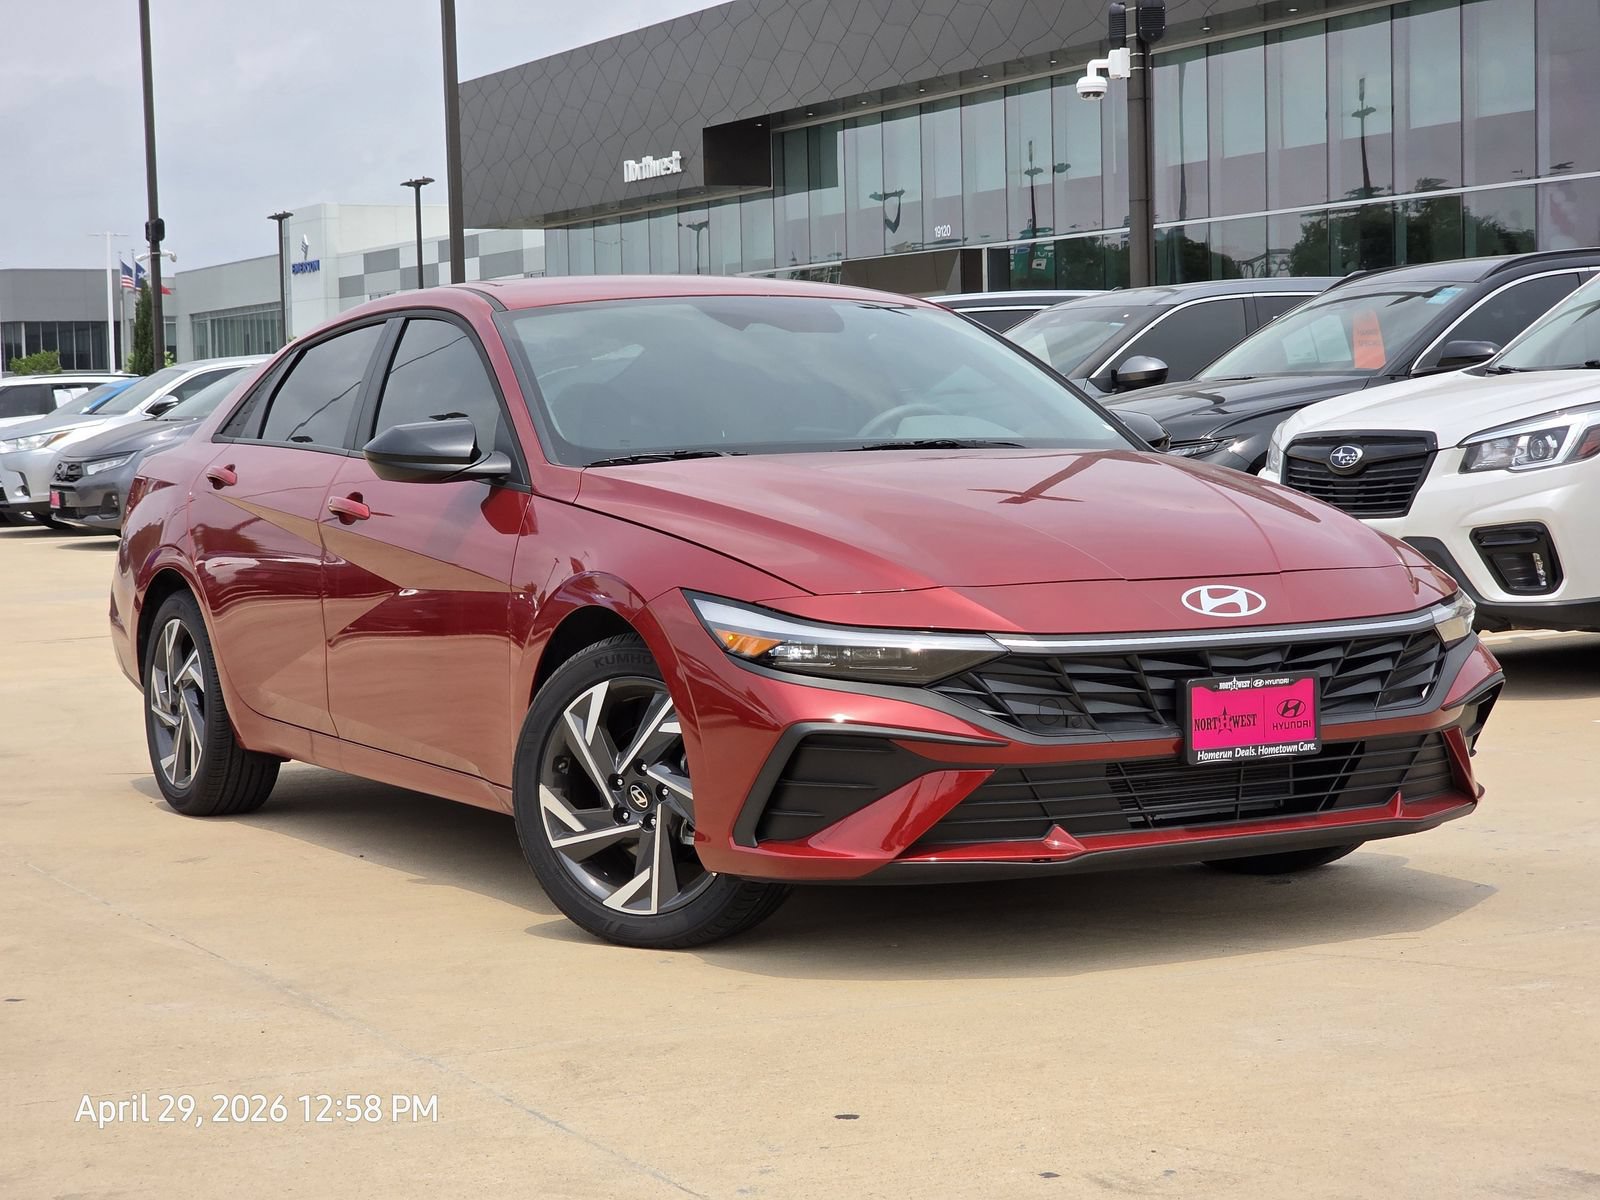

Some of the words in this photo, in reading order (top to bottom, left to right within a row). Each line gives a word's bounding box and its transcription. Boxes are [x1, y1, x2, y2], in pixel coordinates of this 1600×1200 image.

[934, 224, 951, 238] 19120
[1272, 719, 1312, 731] HYUNDAI
[1197, 749, 1233, 761] Homerun
[1234, 746, 1257, 758] Deals.
[1258, 743, 1298, 756] Hometown
[1298, 741, 1317, 752] Care.
